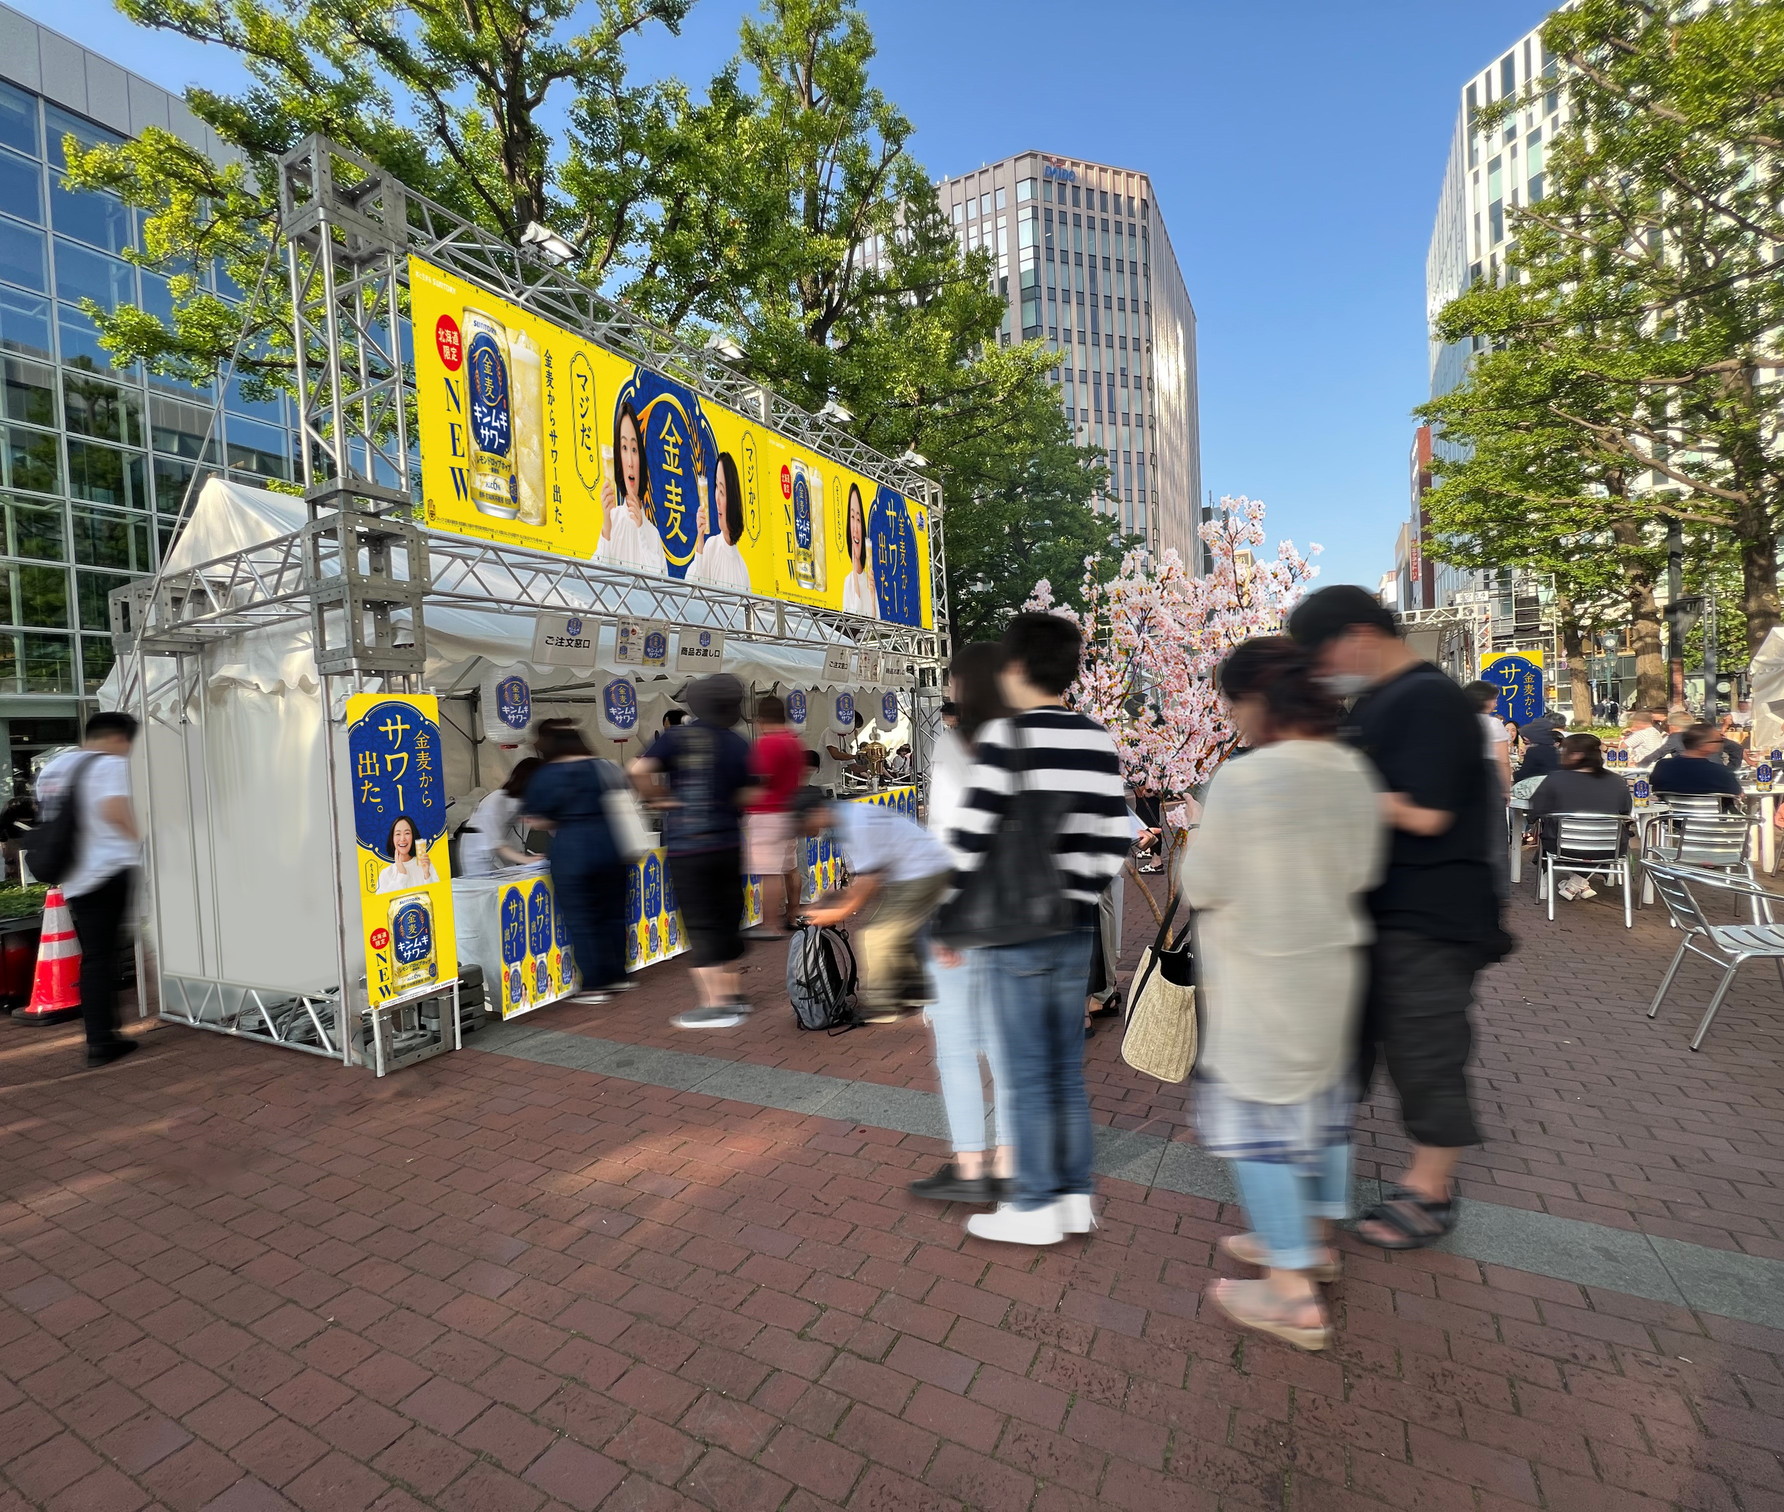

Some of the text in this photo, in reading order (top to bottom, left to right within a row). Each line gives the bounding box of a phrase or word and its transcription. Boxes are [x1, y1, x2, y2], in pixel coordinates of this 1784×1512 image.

[437, 327, 460, 346] 北海道
[442, 345, 458, 362] 限定
[482, 353, 495, 399] 金麦
[443, 376, 469, 502] NEW
[473, 402, 508, 432] キンムギ
[480, 425, 506, 449] サワー
[575, 372, 595, 463] マジだ。
[543, 348, 565, 533] 金麦からサワー出た。
[658, 411, 688, 545] 金麦
[878, 531, 891, 616] 出た。
[885, 498, 898, 614] サワー
[897, 509, 909, 618] 金麦から
[545, 635, 591, 649] ご注文窓口
[680, 646, 721, 658] 商品お渡し口
[502, 705, 529, 715] キンムギ
[511, 683, 523, 703] 金麦
[609, 706, 636, 716] キンムギ
[1499, 663, 1522, 719] サワー
[1523, 671, 1536, 718] 金麦から
[507, 714, 528, 724] サワー
[615, 714, 635, 724] サワー
[357, 750, 384, 813] 出た。
[378, 714, 411, 812] サワー
[413, 729, 433, 808] 金麦から
[648, 863, 656, 914] サワー
[371, 931, 388, 942] 北海道
[374, 938, 387, 948] 限定
[397, 935, 429, 952] キンムギ
[406, 912, 417, 935] 金麦
[508, 898, 518, 958] サワー
[535, 892, 544, 949] サワー
[375, 950, 393, 999] NEW
[403, 948, 427, 961] サワー
